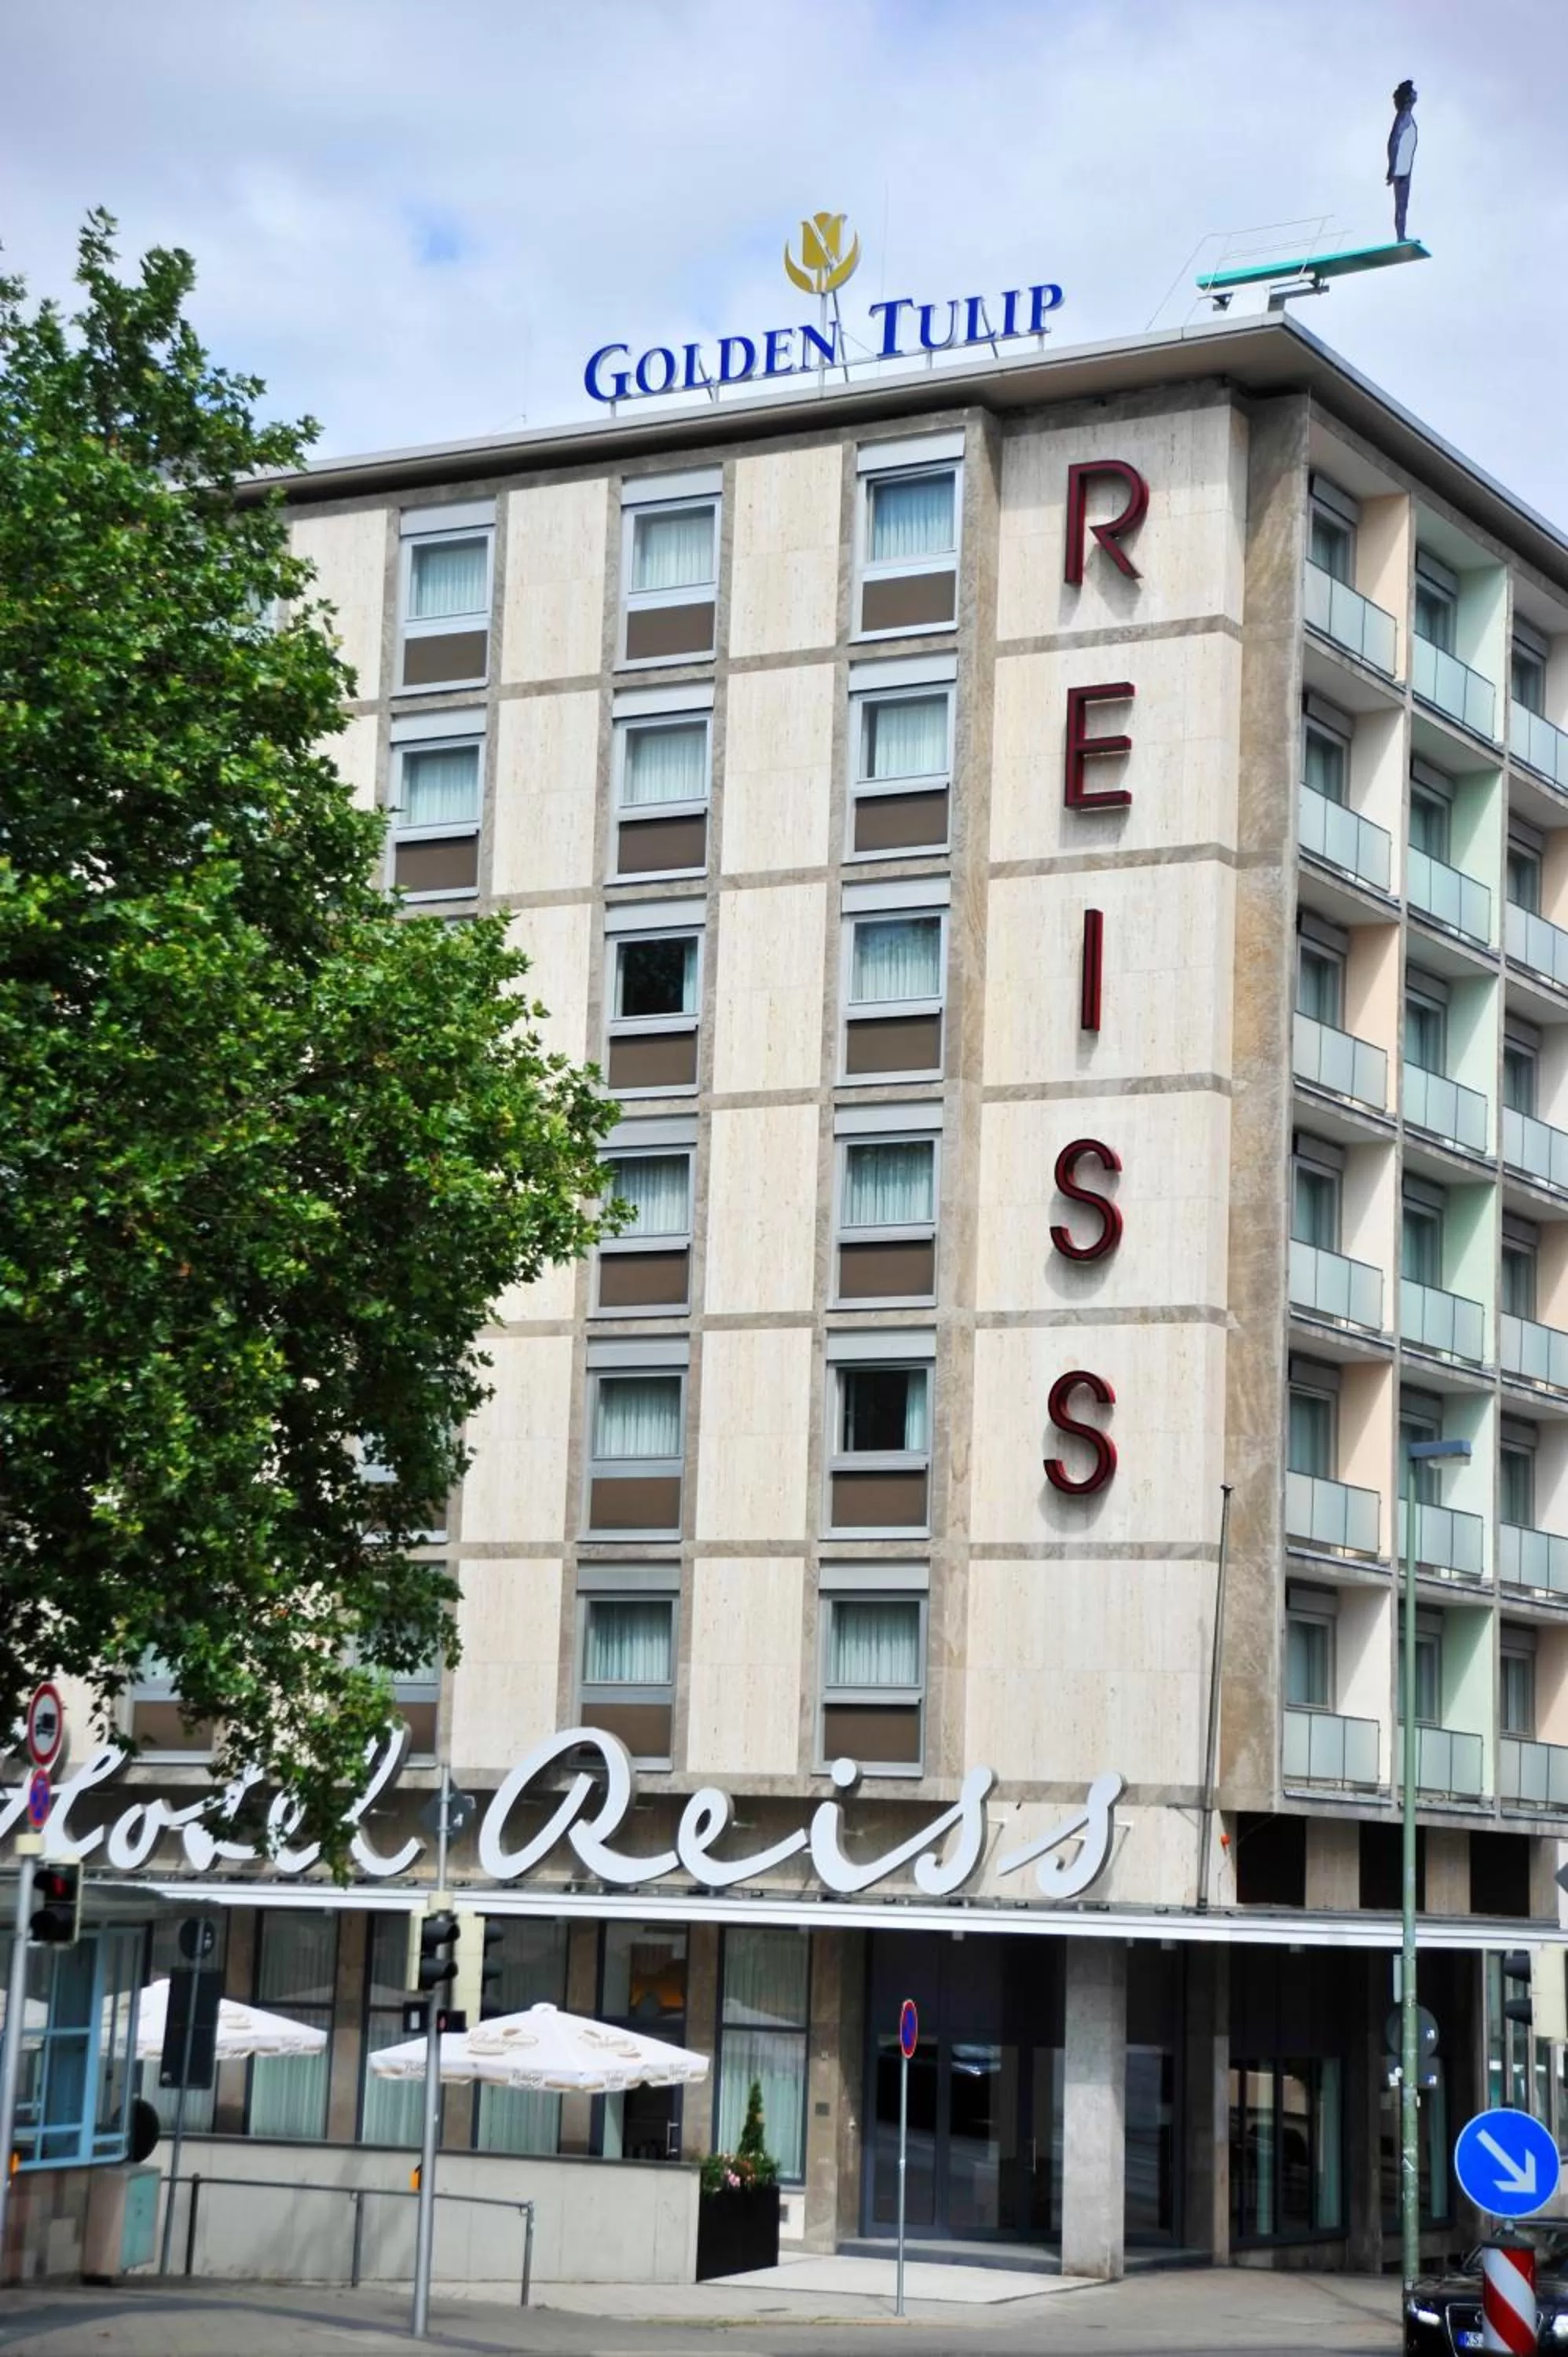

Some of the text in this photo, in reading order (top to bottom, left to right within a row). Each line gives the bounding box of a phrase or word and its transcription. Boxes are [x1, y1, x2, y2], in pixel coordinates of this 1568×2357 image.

[584, 283, 1064, 403] GOLDEN TULIP
[1043, 460, 1149, 1497] REISS
[478, 1727, 1127, 1899] Reiss
